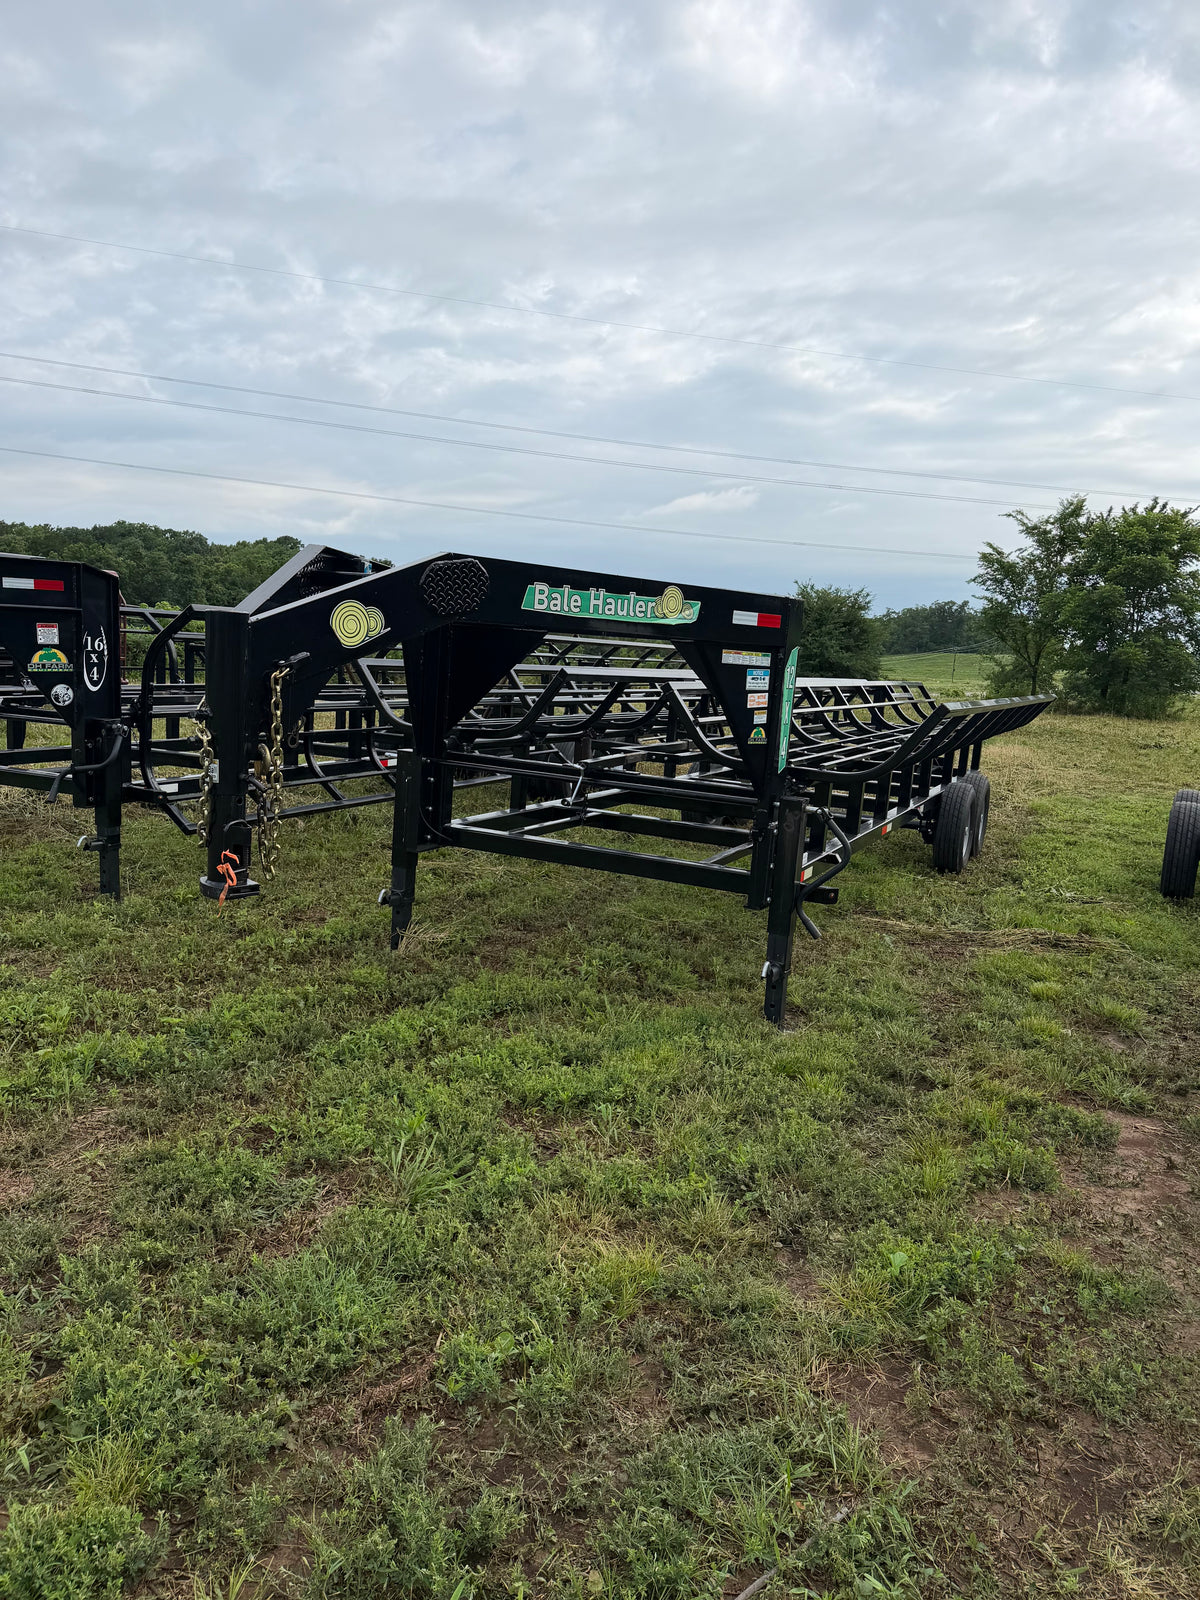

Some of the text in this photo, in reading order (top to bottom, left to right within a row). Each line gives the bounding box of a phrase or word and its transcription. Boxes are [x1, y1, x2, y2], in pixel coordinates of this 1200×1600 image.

[533, 582, 656, 618] Bale Hauler
[86, 636, 104, 651] 16
[89, 666, 99, 681] 4
[785, 666, 796, 689] 12
[783, 701, 791, 725] X
[780, 736, 787, 759] 4
